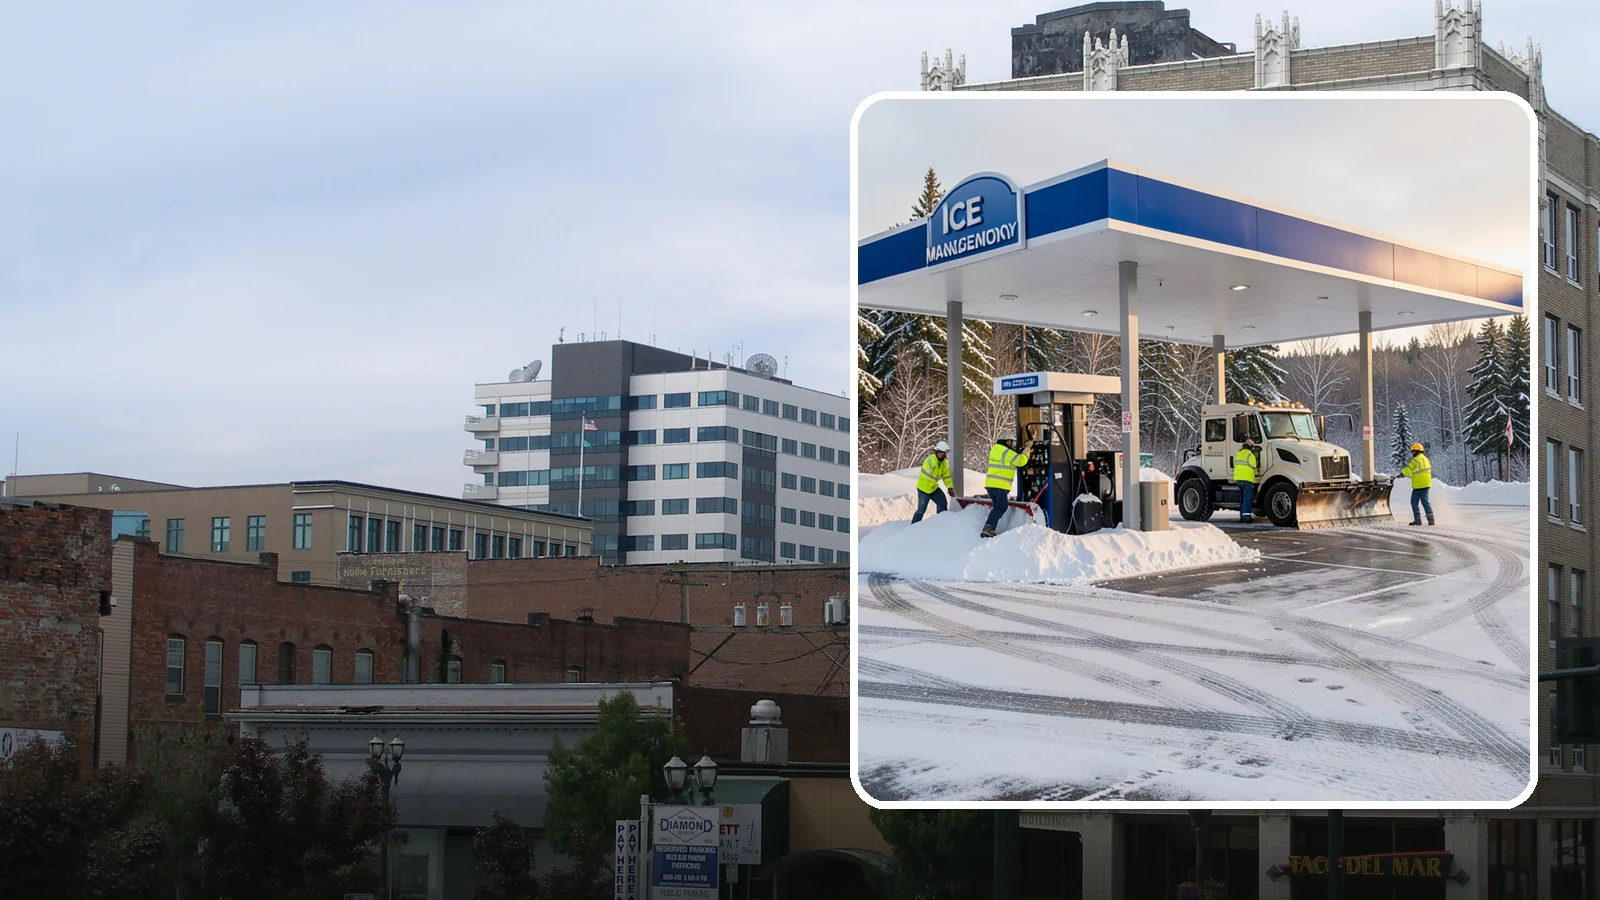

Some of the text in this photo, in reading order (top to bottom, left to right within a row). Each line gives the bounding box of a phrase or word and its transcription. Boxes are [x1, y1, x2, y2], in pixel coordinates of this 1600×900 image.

[942, 196, 981, 234] ICE
[370, 566, 427, 576] Furnishers
[660, 818, 713, 832] DIAMOND
[1022, 815, 1070, 828] BUILDING
[655, 845, 716, 854] RESERVED PARKING
[616, 824, 625, 894] PAY HERE
[627, 824, 637, 894] PAY HERE
[722, 851, 739, 862] Soup
[671, 862, 701, 870] PATRONS
[1290, 855, 1442, 877] TAC DEL MAR
[660, 889, 710, 898] PUBLIC PARKING
